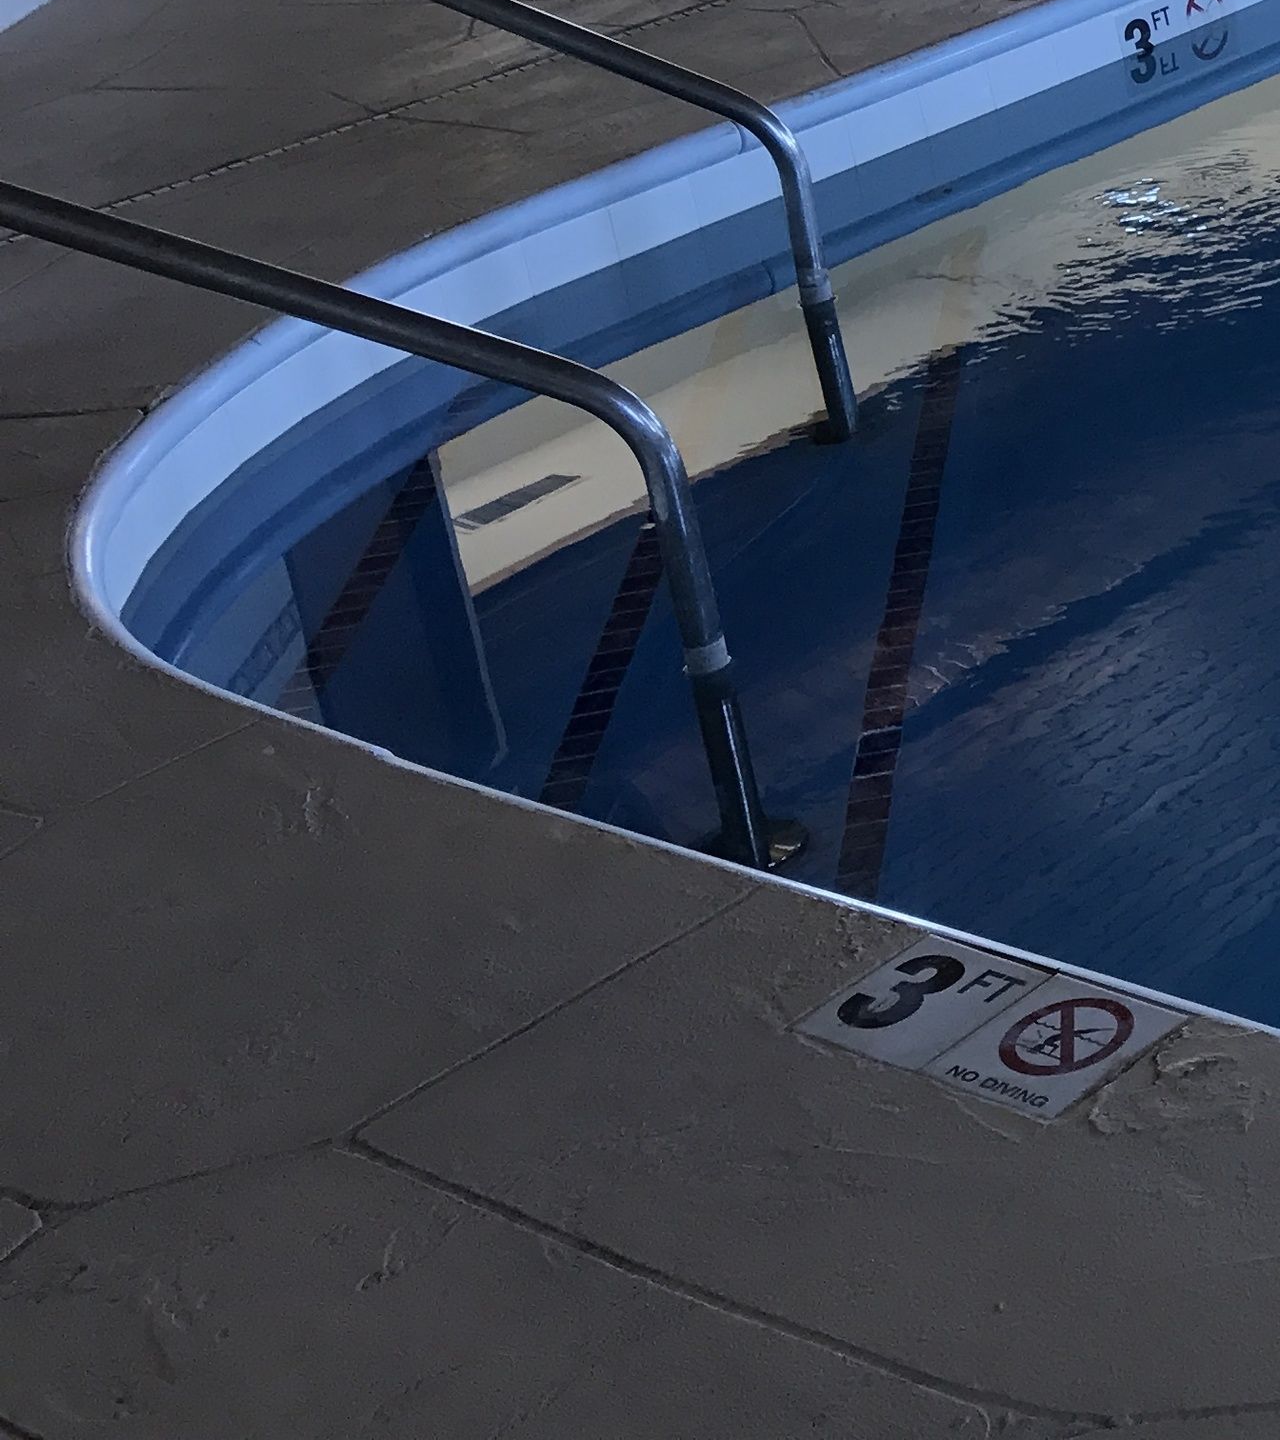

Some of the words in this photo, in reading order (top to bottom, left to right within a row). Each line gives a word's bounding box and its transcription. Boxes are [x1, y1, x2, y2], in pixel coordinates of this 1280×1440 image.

[1124, 18, 1155, 53] 3
[1151, 6, 1170, 30] FT
[836, 954, 966, 1029] 3
[957, 969, 1026, 1003] FT
[945, 1064, 980, 1082] NO
[979, 1077, 1050, 1108] DIVING
